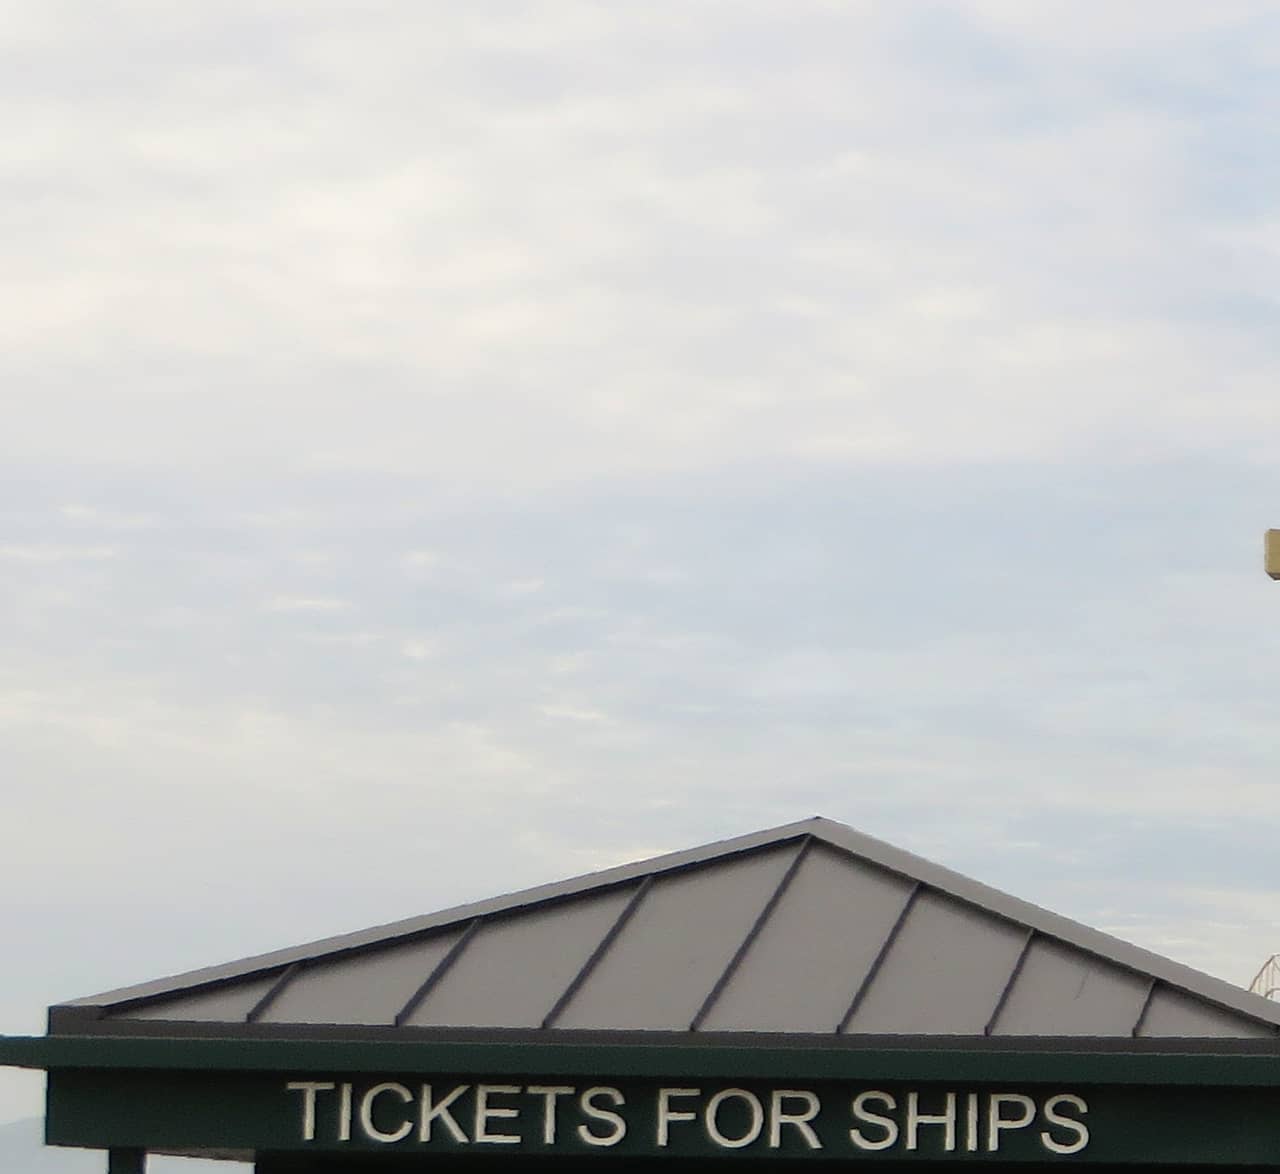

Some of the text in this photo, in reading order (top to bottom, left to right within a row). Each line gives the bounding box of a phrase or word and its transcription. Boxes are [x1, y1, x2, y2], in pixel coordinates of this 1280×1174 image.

[286, 1081, 1091, 1154] TICKETS FOR SHIPS
